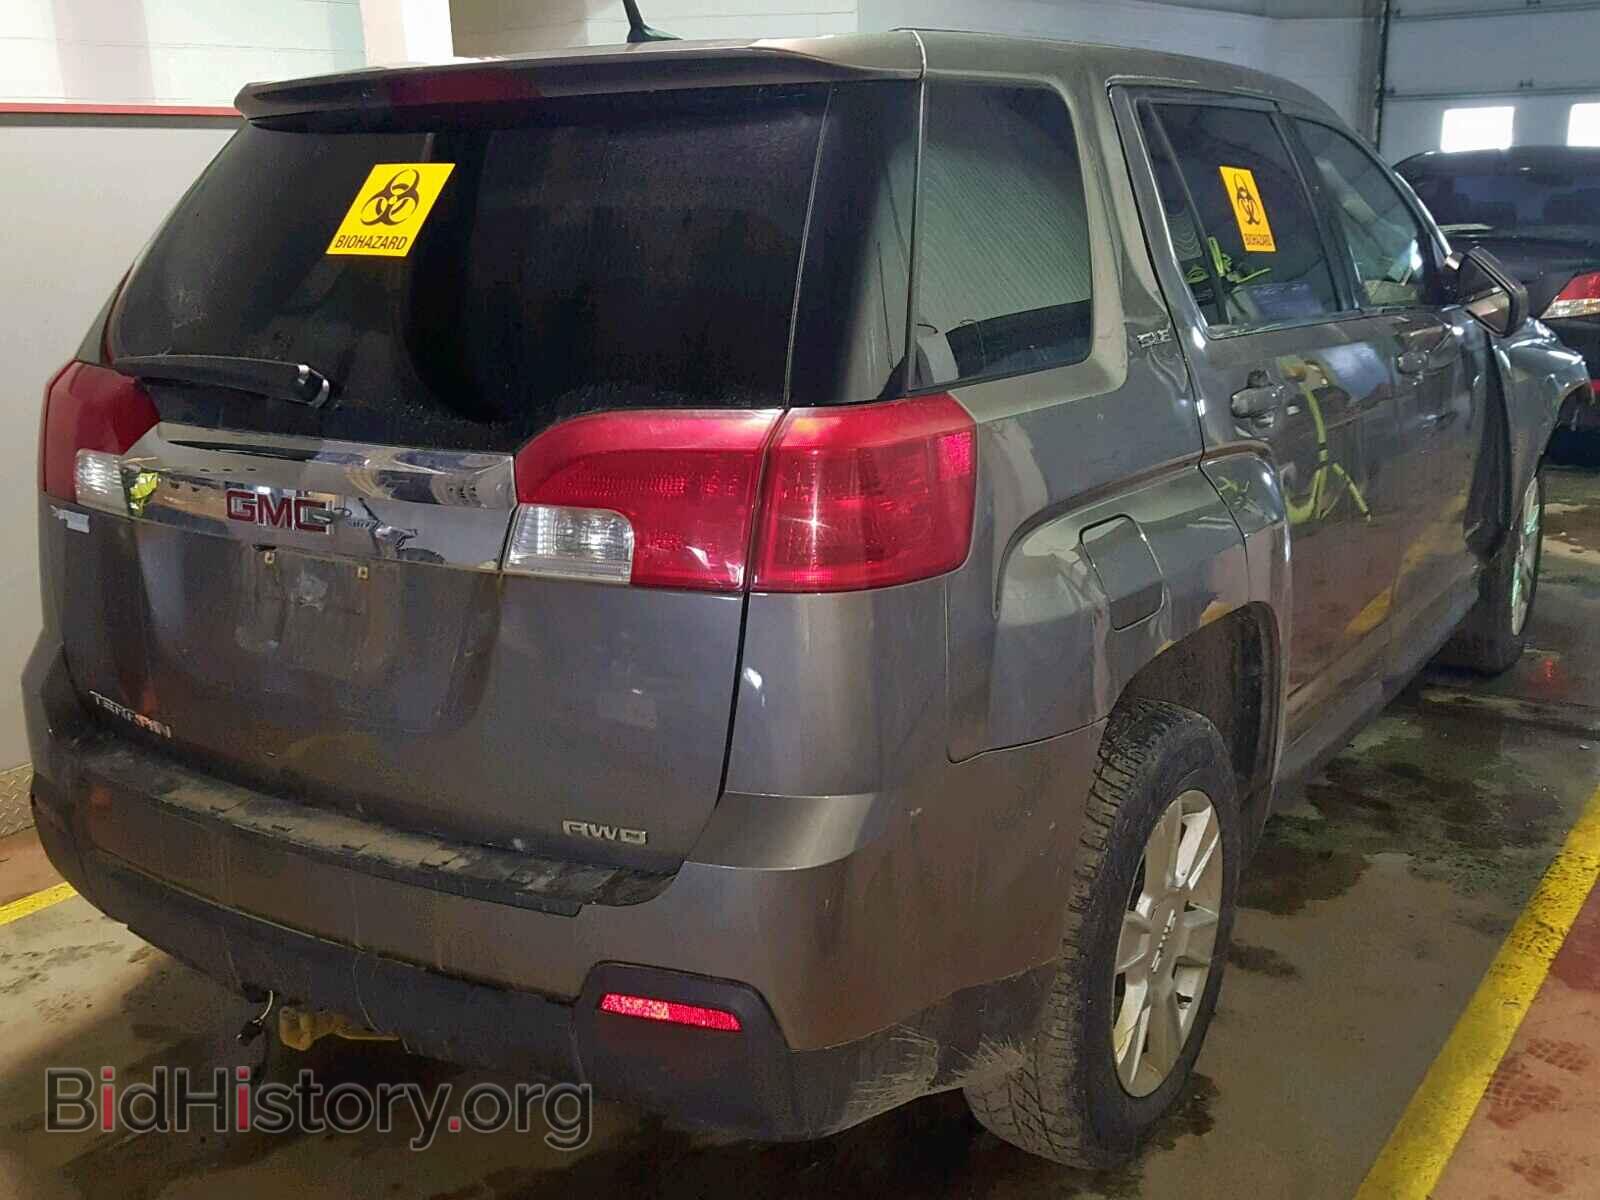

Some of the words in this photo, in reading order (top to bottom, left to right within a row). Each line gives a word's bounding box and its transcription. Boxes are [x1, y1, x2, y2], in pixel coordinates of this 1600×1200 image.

[335, 234, 408, 250] BIOHAZARD
[225, 488, 333, 534] GMC
[562, 818, 647, 845] AWD
